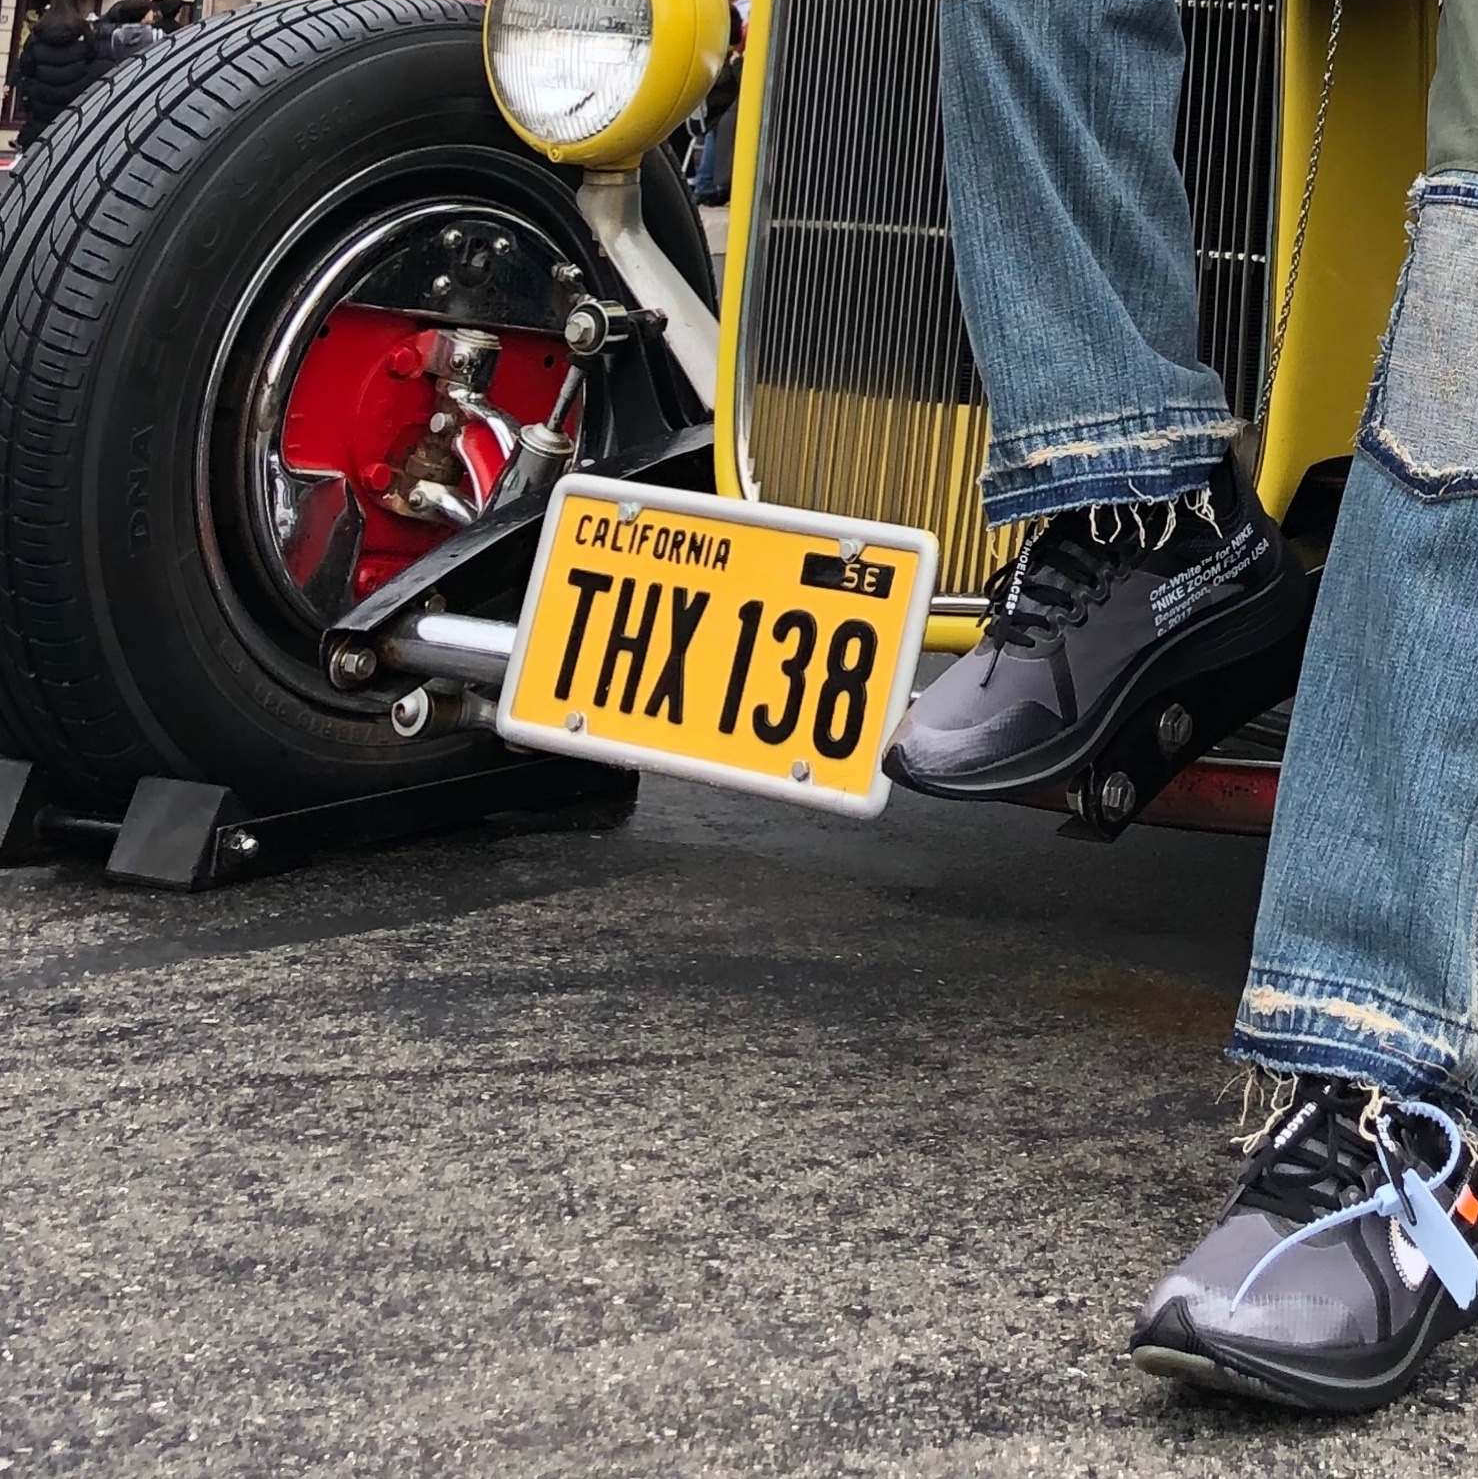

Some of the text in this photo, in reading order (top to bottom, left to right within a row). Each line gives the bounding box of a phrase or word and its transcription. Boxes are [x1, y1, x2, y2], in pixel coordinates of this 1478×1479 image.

[127, 424, 154, 552] DNA
[574, 514, 732, 572] CALIFORNIA
[1215, 546, 1231, 562] for
[1231, 522, 1254, 550] NIKE
[1155, 537, 1270, 626] Beaverton, Oregon USA
[1186, 562, 1222, 593] ZOOM
[1168, 607, 1193, 628] 2017
[554, 568, 878, 760] THX 138
